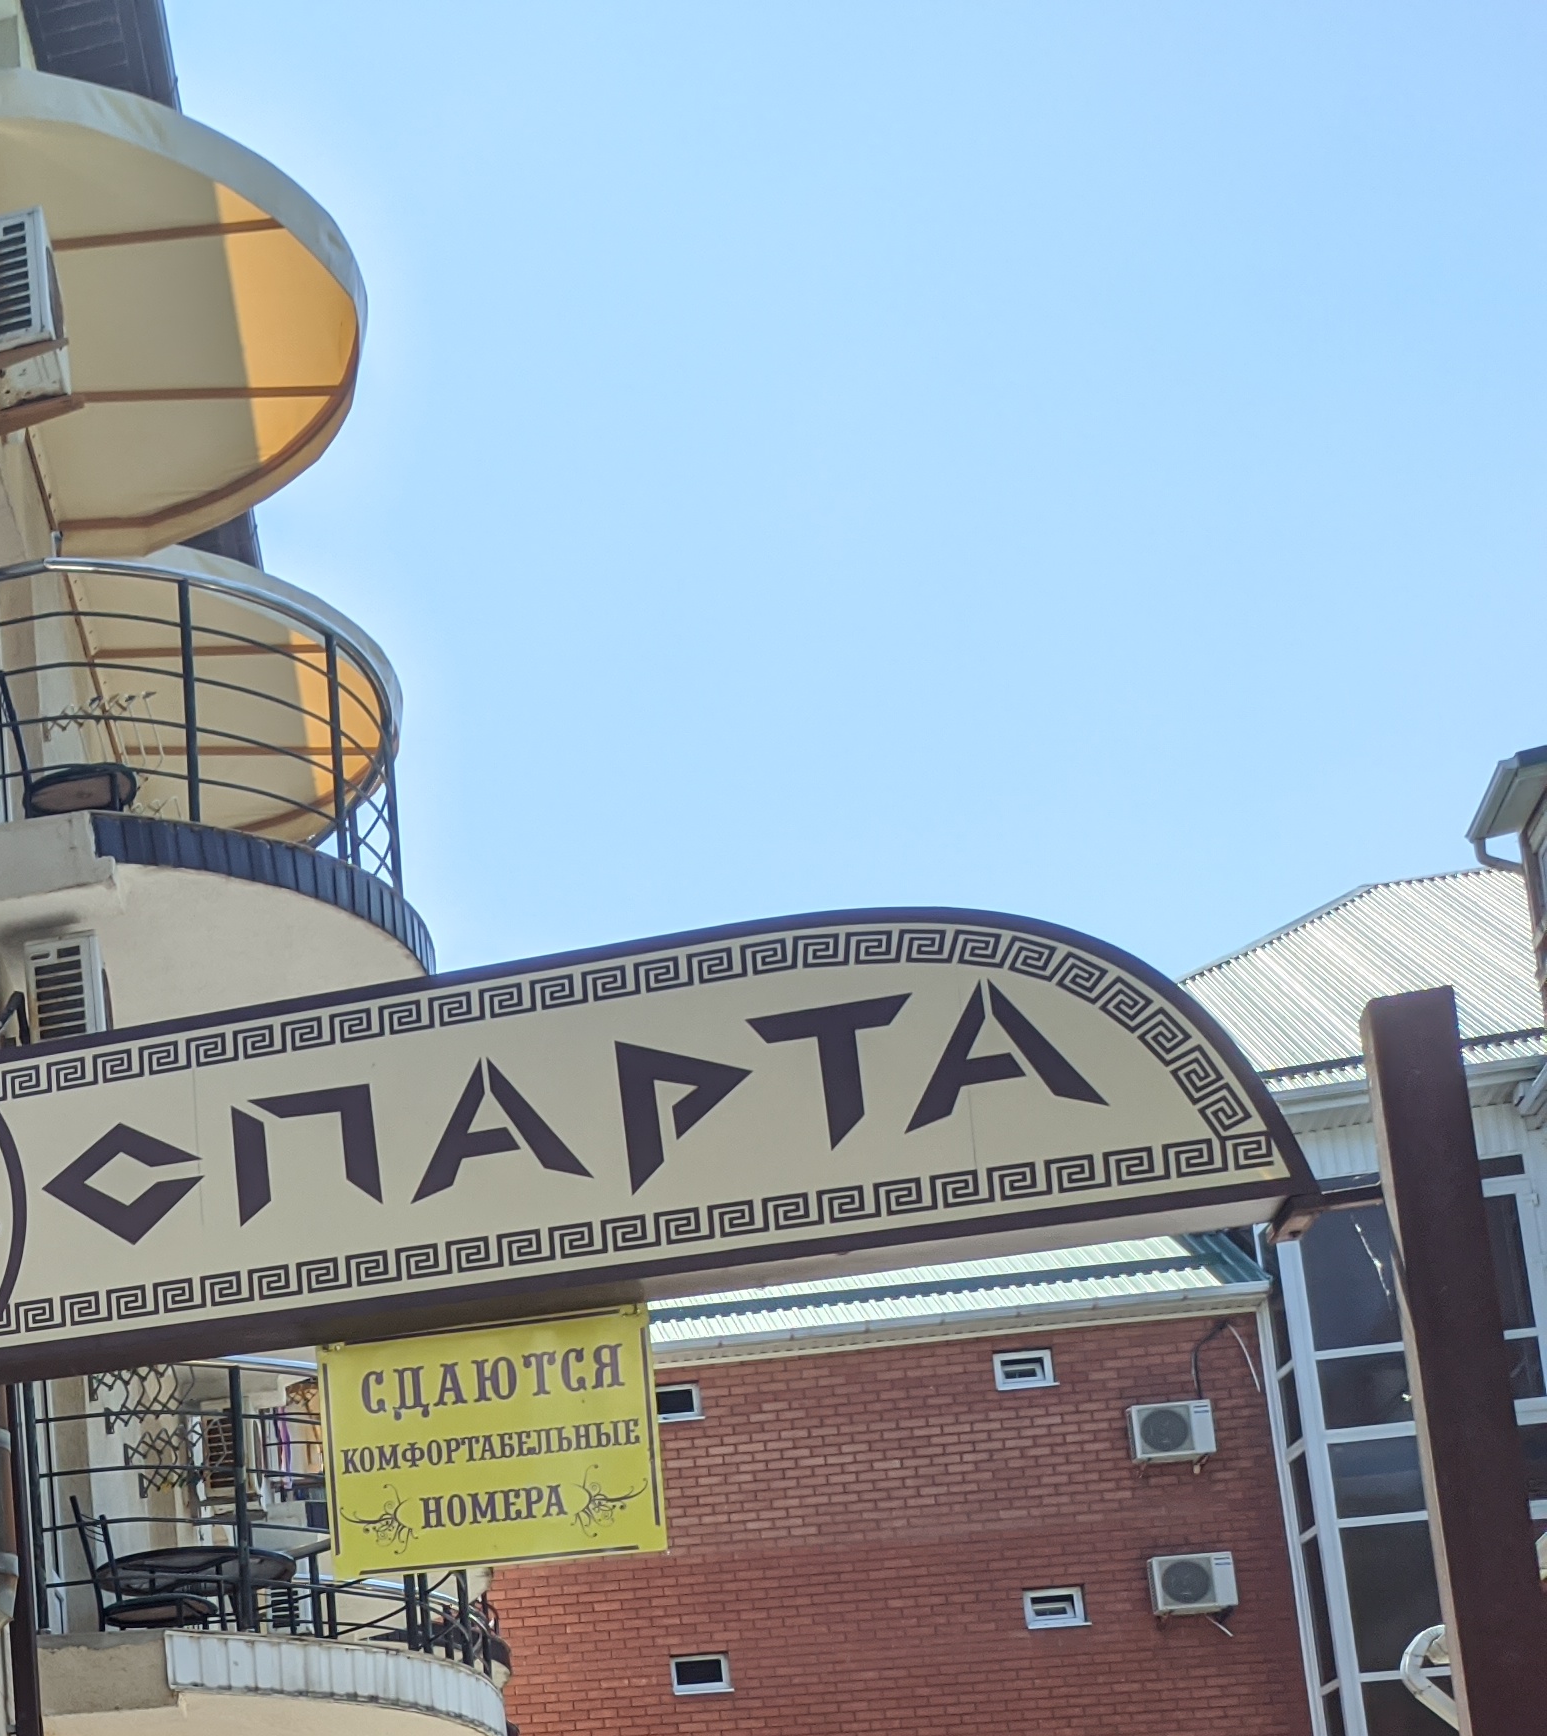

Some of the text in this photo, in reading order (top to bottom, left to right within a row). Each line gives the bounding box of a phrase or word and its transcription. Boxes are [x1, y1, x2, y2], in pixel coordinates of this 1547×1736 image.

[43, 980, 1109, 1246] СПАРТА
[360, 1342, 625, 1421] СДАЮТСЯ
[340, 1417, 641, 1475] КОМФОРТАБЕЛЬНЫЕ
[419, 1483, 568, 1531] НОМЕРА
